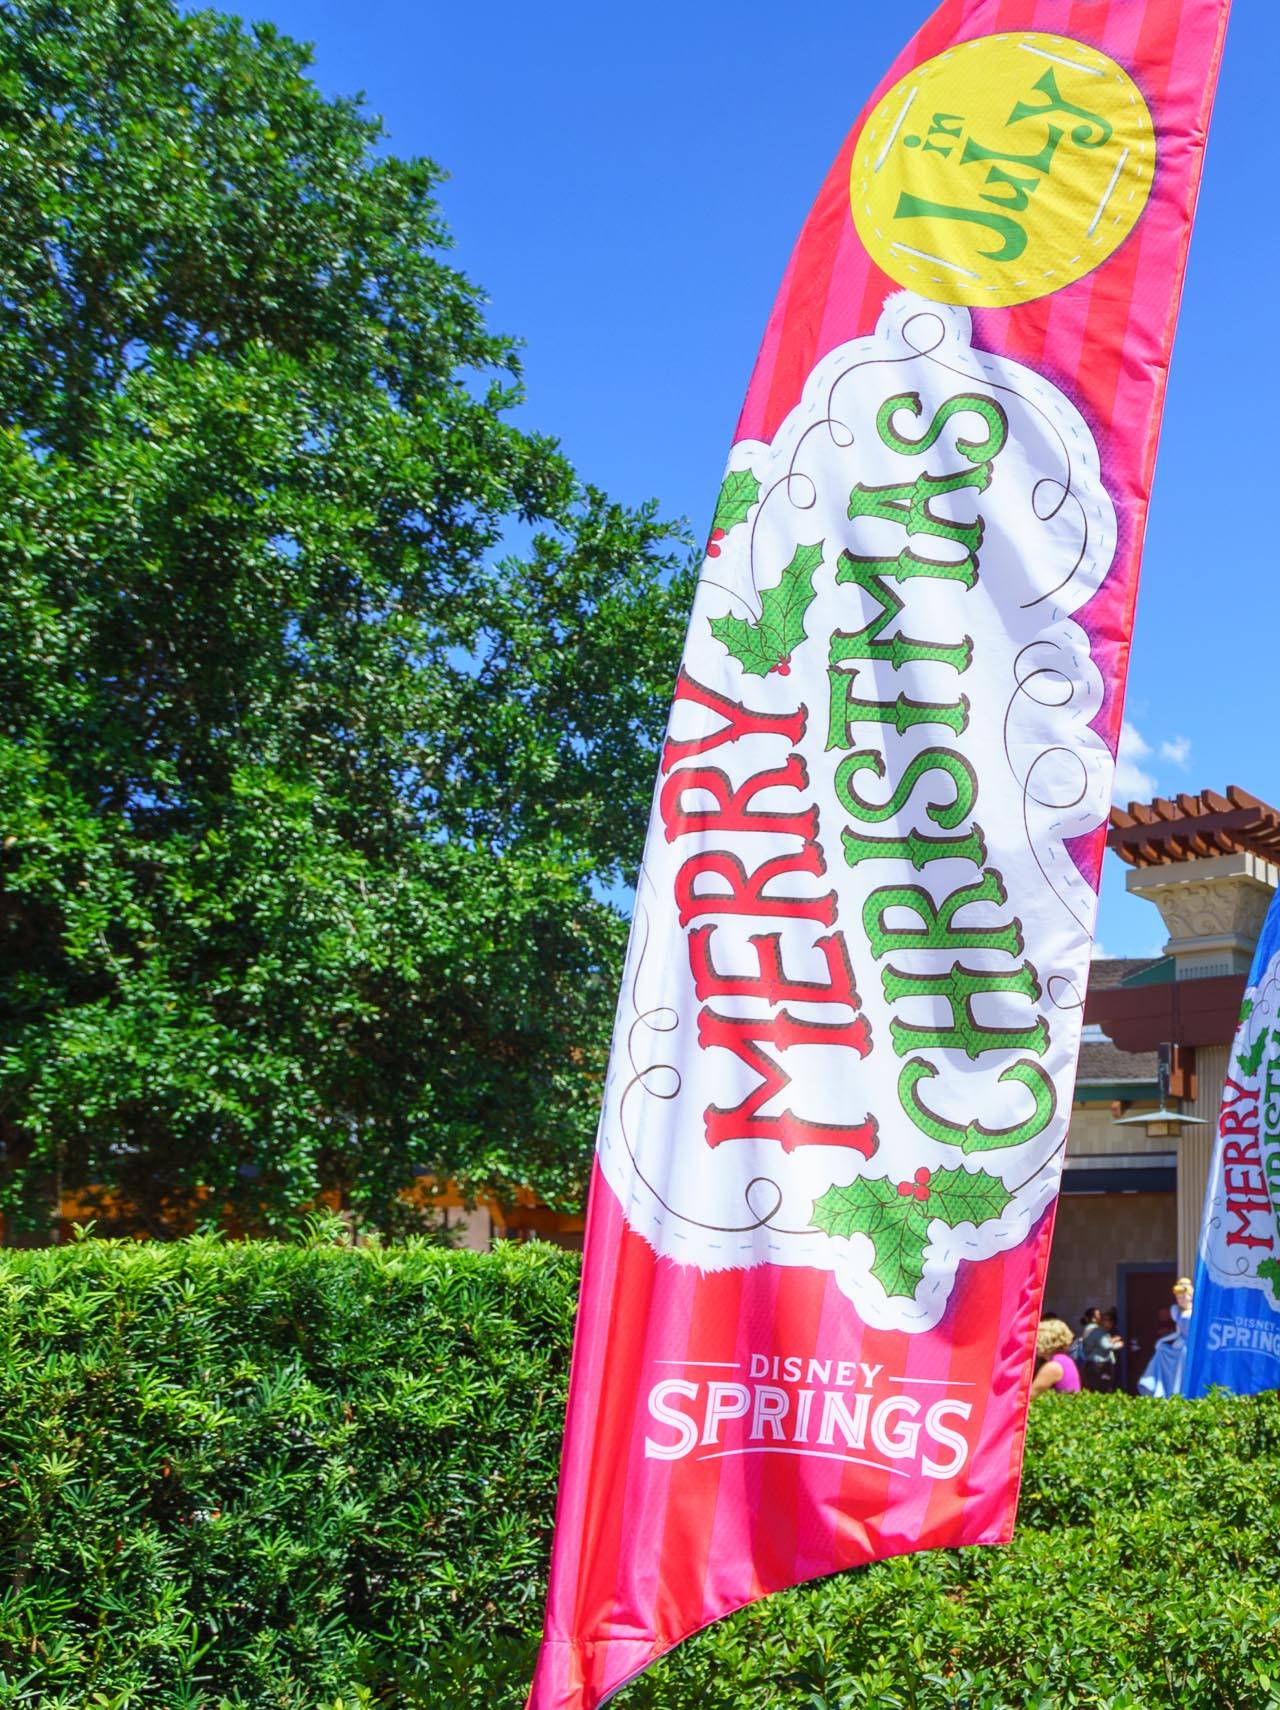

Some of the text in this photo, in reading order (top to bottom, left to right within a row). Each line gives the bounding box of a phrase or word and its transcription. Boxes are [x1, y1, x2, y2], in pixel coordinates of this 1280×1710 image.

[903, 112, 965, 158] in
[825, 391, 1057, 1157] CHRISTMAS
[661, 664, 881, 1161] MERRY
[1219, 1075, 1274, 1252] MERRY
[748, 1353, 884, 1389] DISNEY
[1235, 1316, 1276, 1332] DISNEY
[644, 1378, 973, 1481] SPRINGS
